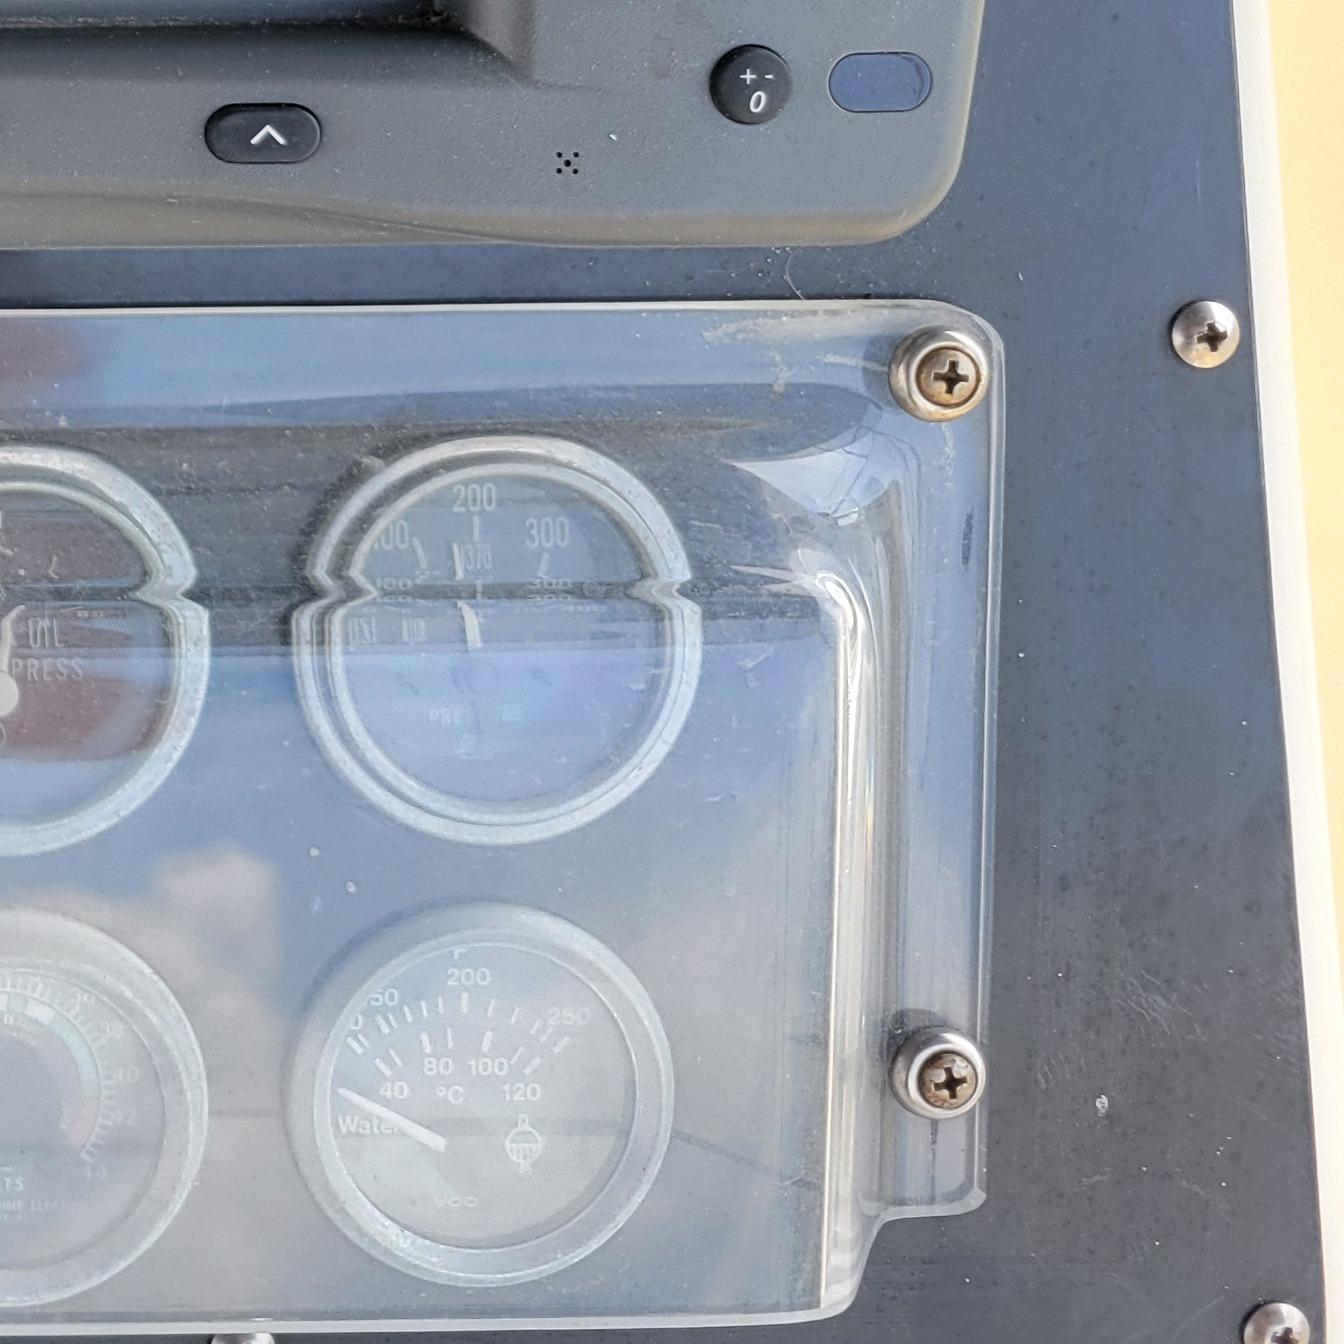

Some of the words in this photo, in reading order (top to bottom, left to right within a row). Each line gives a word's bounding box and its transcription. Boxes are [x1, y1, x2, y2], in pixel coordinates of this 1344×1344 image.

[749, 90, 767, 114] 0
[452, 482, 497, 513] 200
[525, 516, 570, 549] 300
[446, 968, 492, 987] 200
[546, 1006, 591, 1026] 250
[423, 1058, 454, 1076] 80
[469, 1058, 509, 1076] 100
[379, 1081, 410, 1100] 40
[502, 1083, 541, 1101] 120
